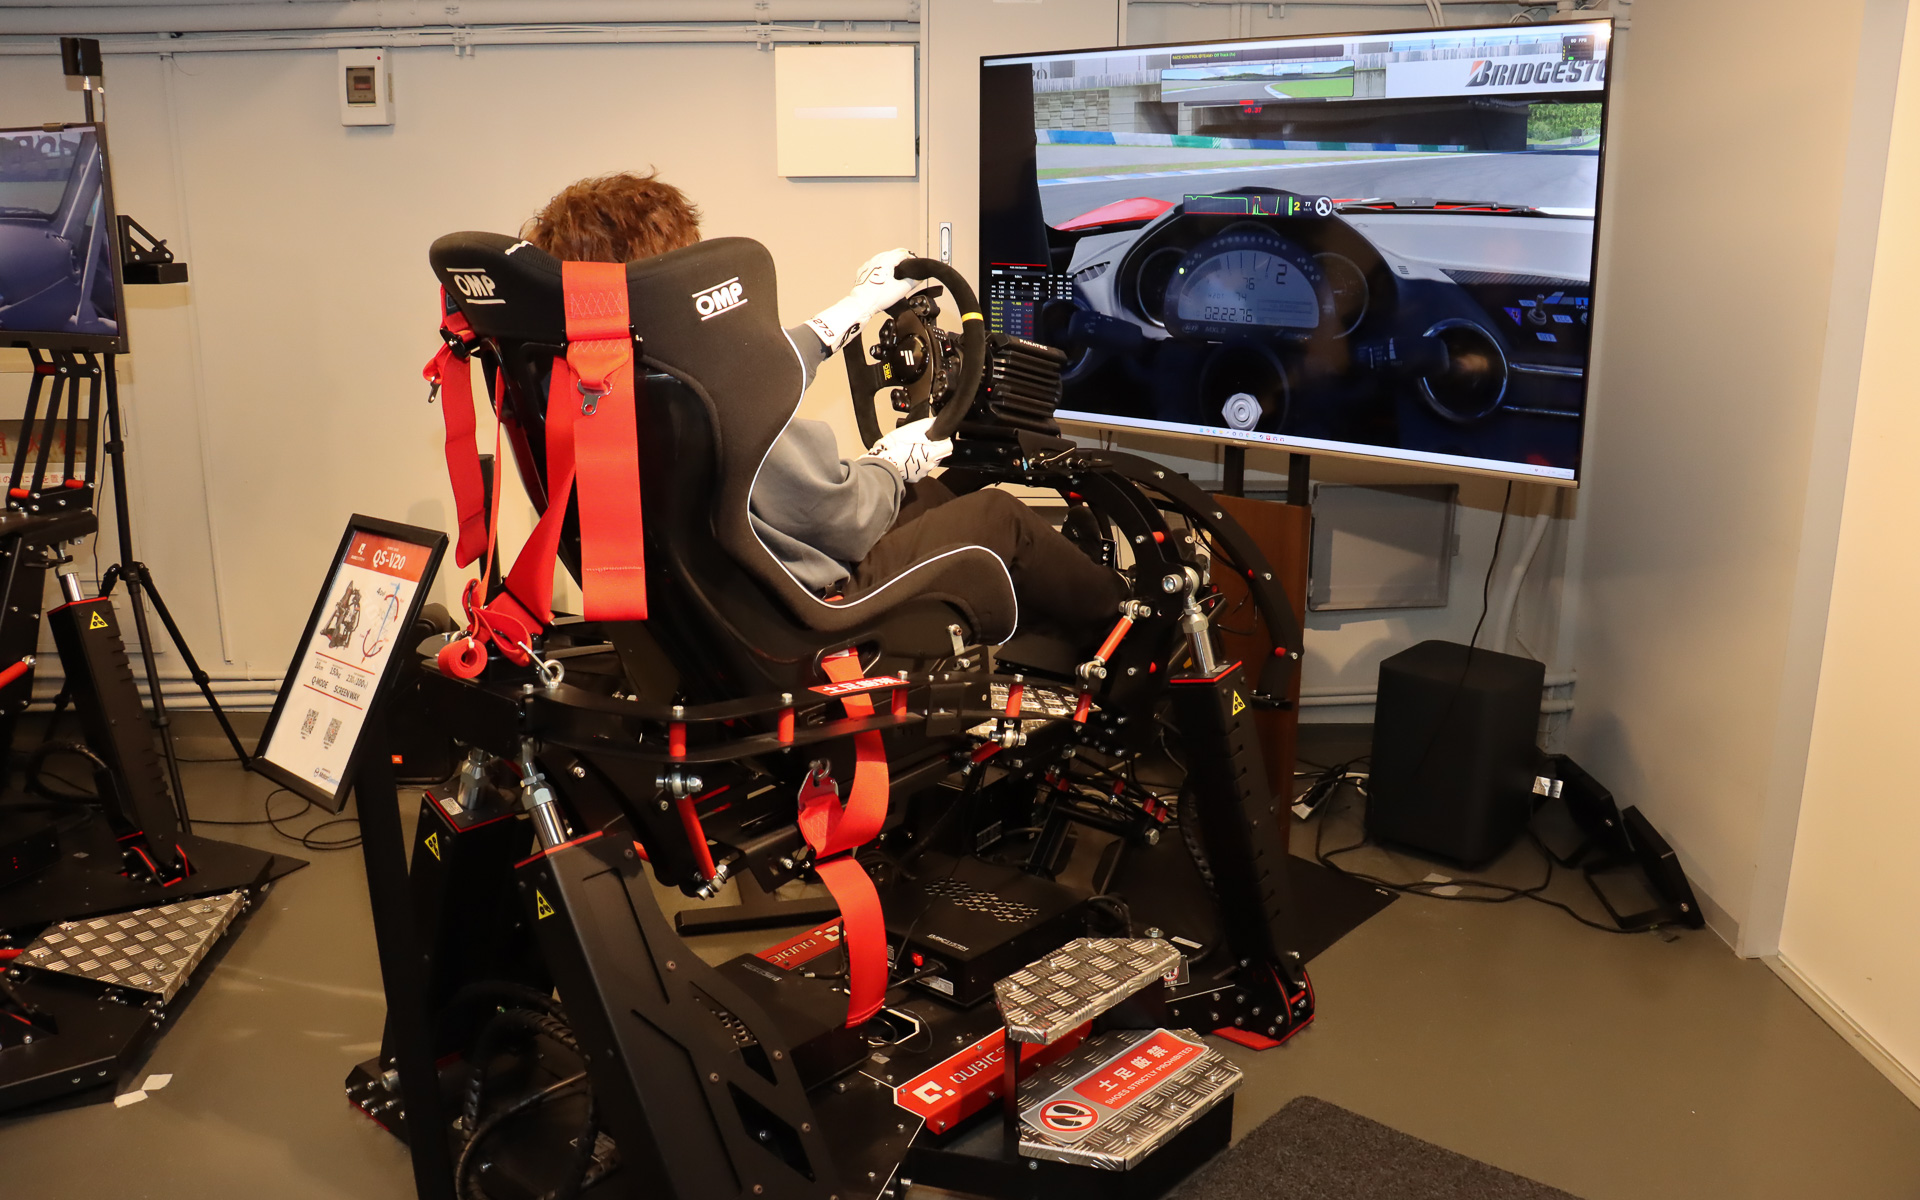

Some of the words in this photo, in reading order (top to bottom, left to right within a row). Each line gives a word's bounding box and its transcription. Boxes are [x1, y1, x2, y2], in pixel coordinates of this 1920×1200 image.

[1294, 201, 1301, 212] 2
[453, 273, 497, 298] OMP
[1275, 263, 1288, 285] 2
[695, 281, 744, 316] OMP
[372, 549, 407, 571] QS-V20
[1098, 1045, 1169, 1092] 土足厳禁
[1104, 1088, 1131, 1105] SHOES
[1126, 1069, 1158, 1092] STRICTLY
[1155, 1046, 1194, 1072] PROHIBITED
